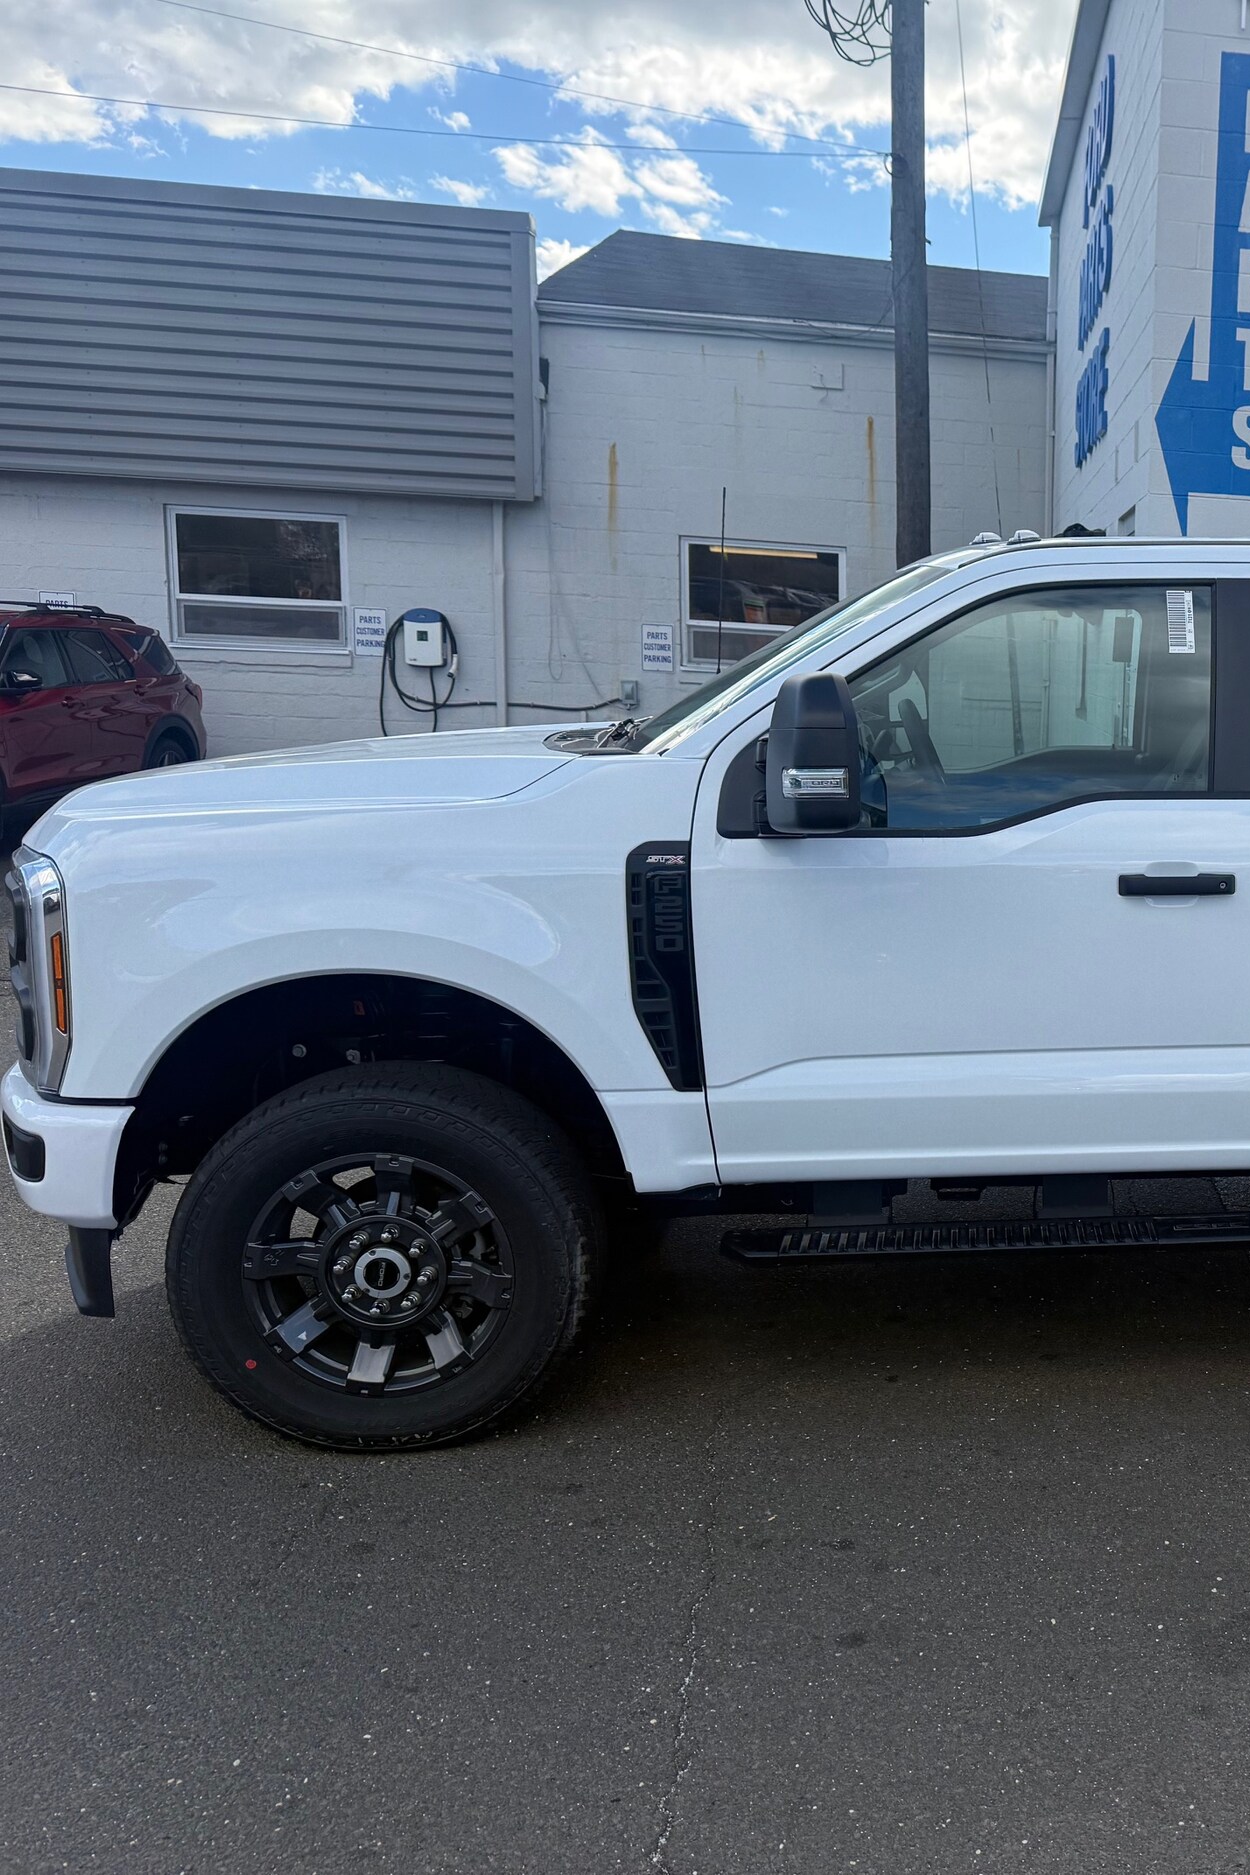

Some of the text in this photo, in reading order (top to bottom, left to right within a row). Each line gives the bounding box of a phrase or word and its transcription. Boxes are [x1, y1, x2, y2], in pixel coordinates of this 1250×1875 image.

[1074, 326, 1111, 470] STORE
[359, 615, 382, 625] PARTS
[356, 627, 385, 636] CUSTOMER
[646, 631, 668, 640] PARTS
[643, 642, 672, 652] CUSTOMER
[643, 654, 672, 664] PARKING
[646, 855, 686, 865] STX
